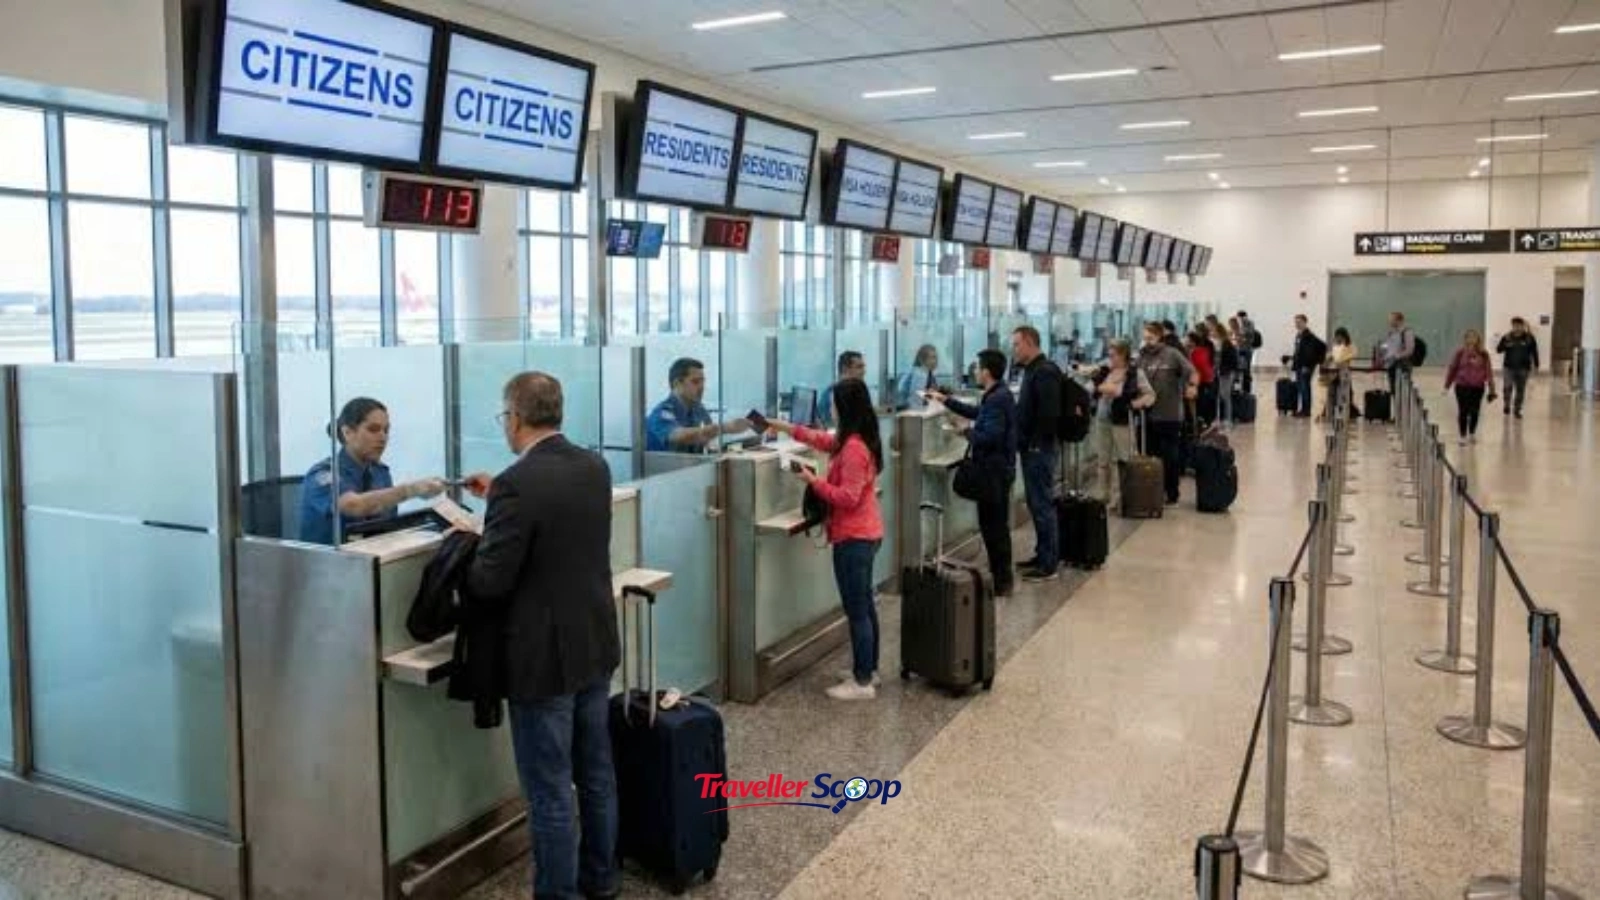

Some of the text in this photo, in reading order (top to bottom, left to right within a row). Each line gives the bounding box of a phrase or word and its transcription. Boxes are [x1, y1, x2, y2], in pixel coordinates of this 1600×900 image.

[241, 41, 413, 108] CITIZENS
[455, 87, 573, 139] CITIZENS
[645, 132, 730, 169] RESIDENTS
[740, 152, 808, 185] RESIDENTS
[419, 187, 473, 224] 113
